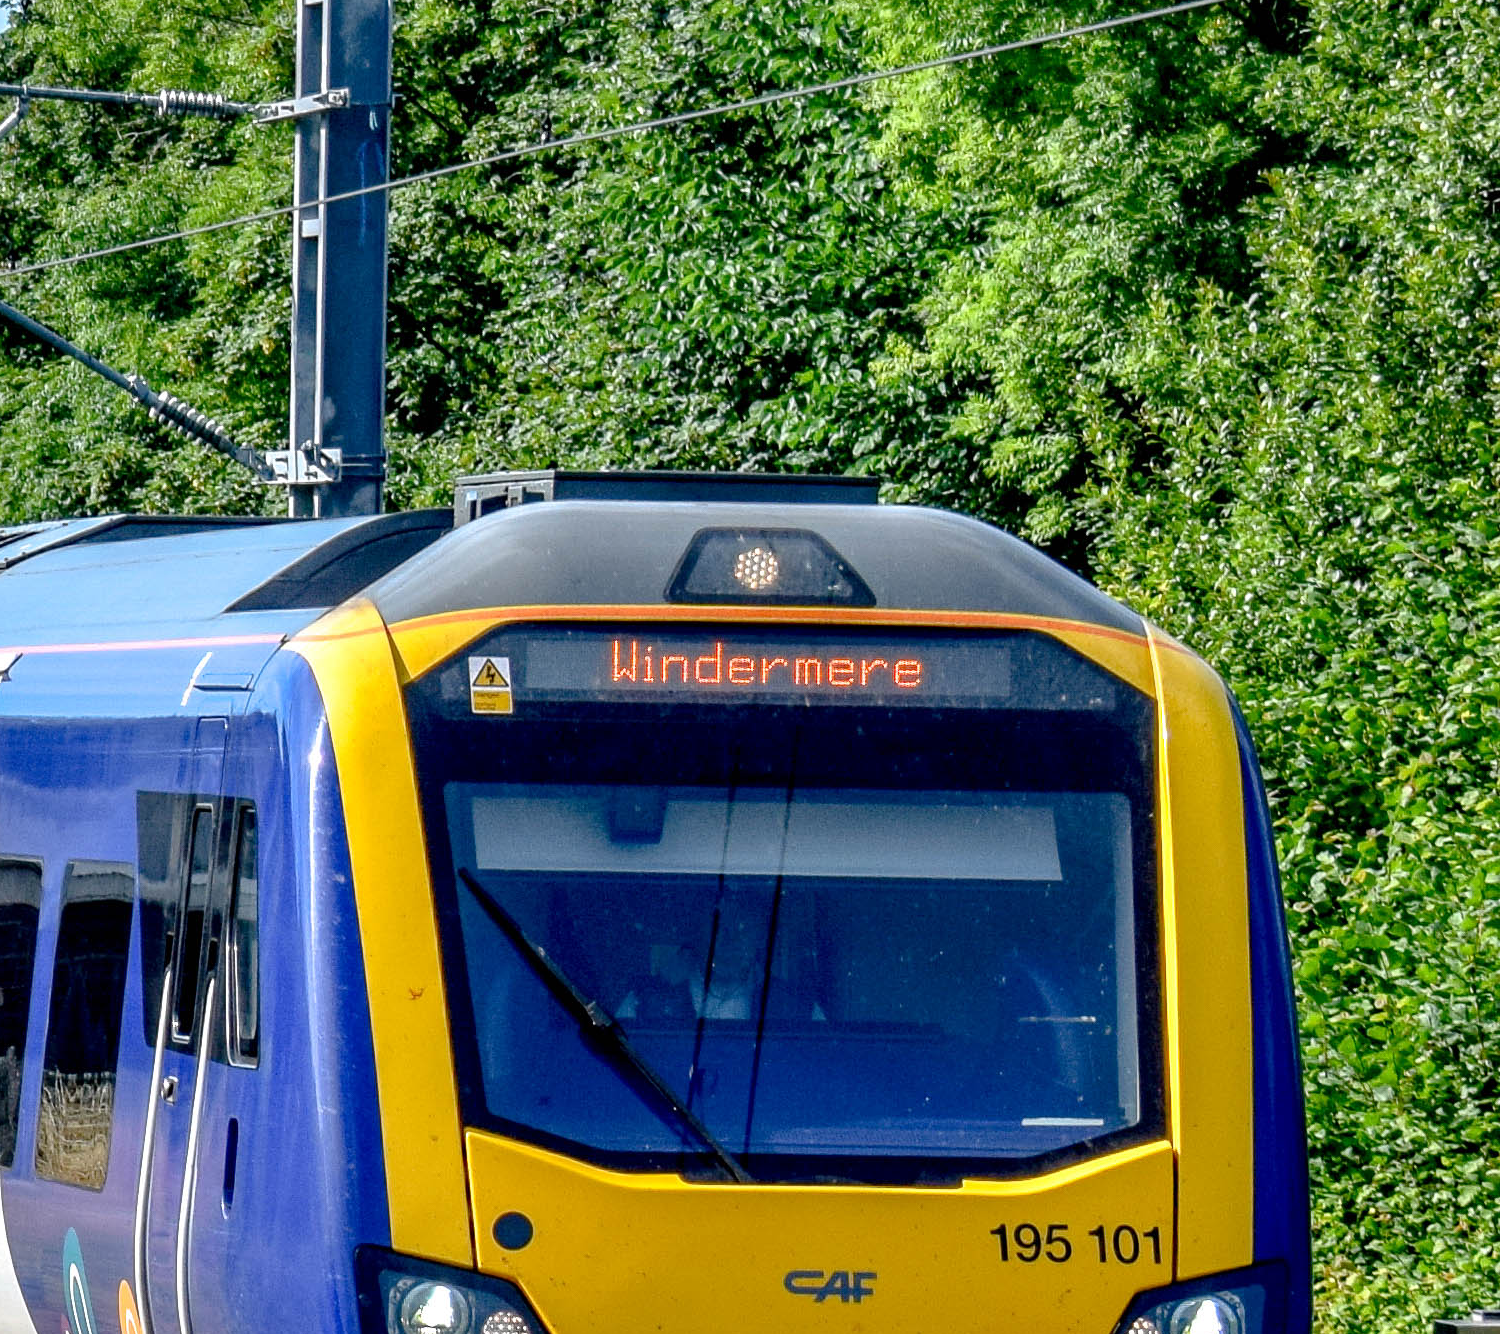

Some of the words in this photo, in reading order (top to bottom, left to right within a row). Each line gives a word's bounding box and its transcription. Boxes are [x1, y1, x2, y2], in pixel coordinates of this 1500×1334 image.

[611, 639, 922, 688] Windermere
[990, 1222, 1073, 1264] 195
[1088, 1223, 1163, 1265] 101
[783, 1269, 878, 1304] CAF
